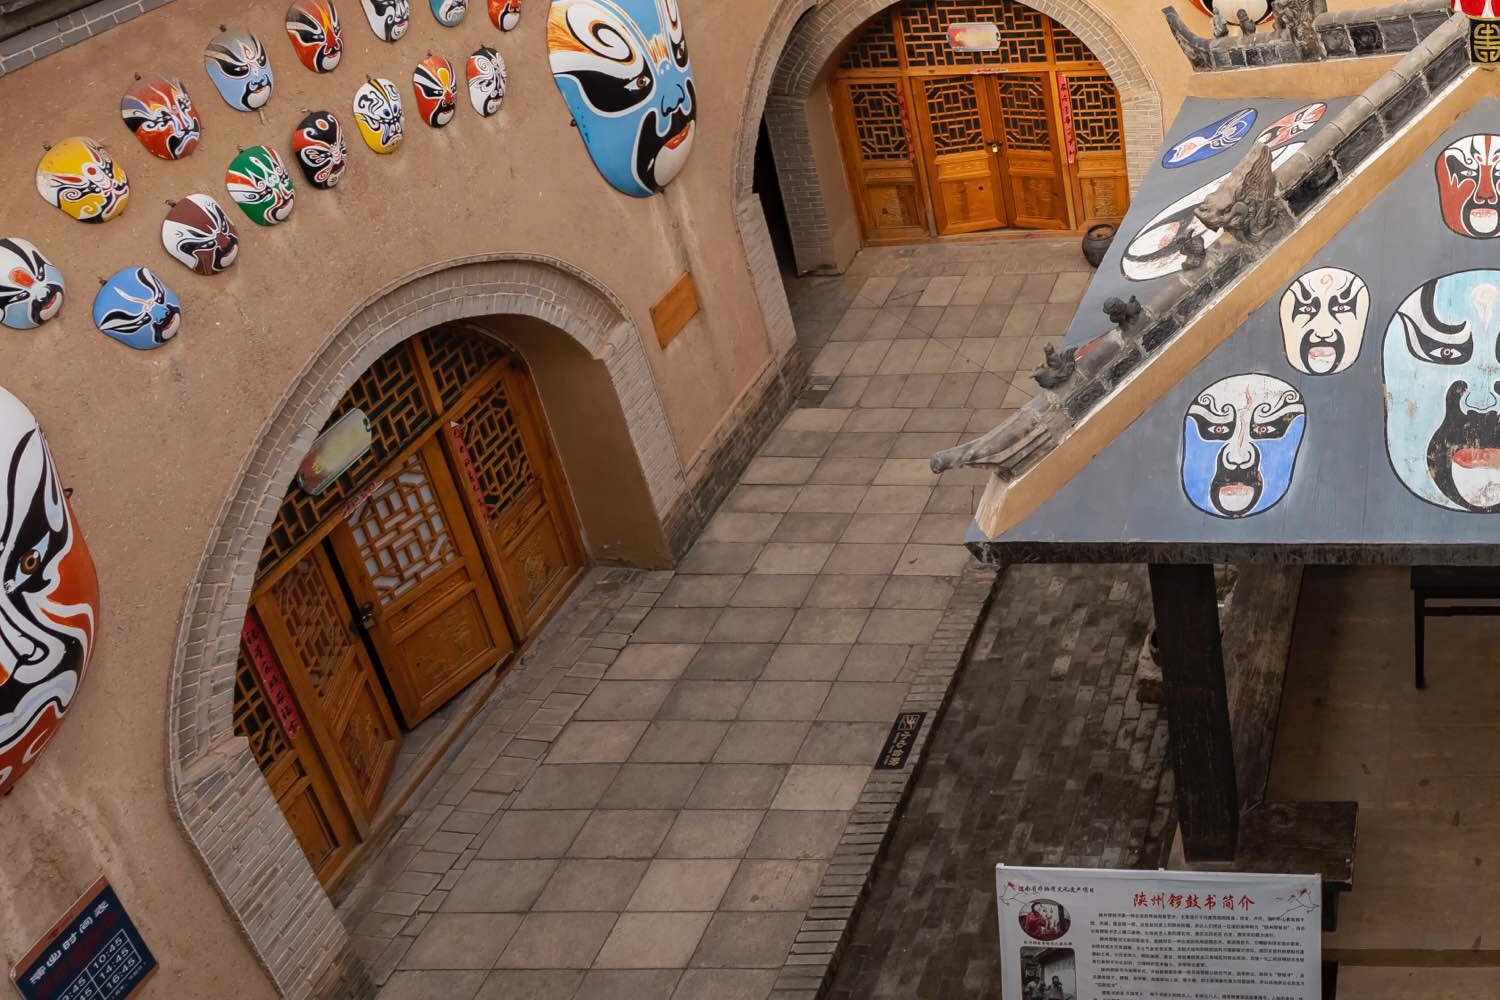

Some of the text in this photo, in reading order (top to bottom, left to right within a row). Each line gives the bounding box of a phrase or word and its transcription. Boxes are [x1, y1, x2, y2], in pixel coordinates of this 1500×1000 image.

[92, 937, 123, 969] 10:45
[99, 947, 129, 980] 14:45
[106, 957, 136, 990] 16:45
